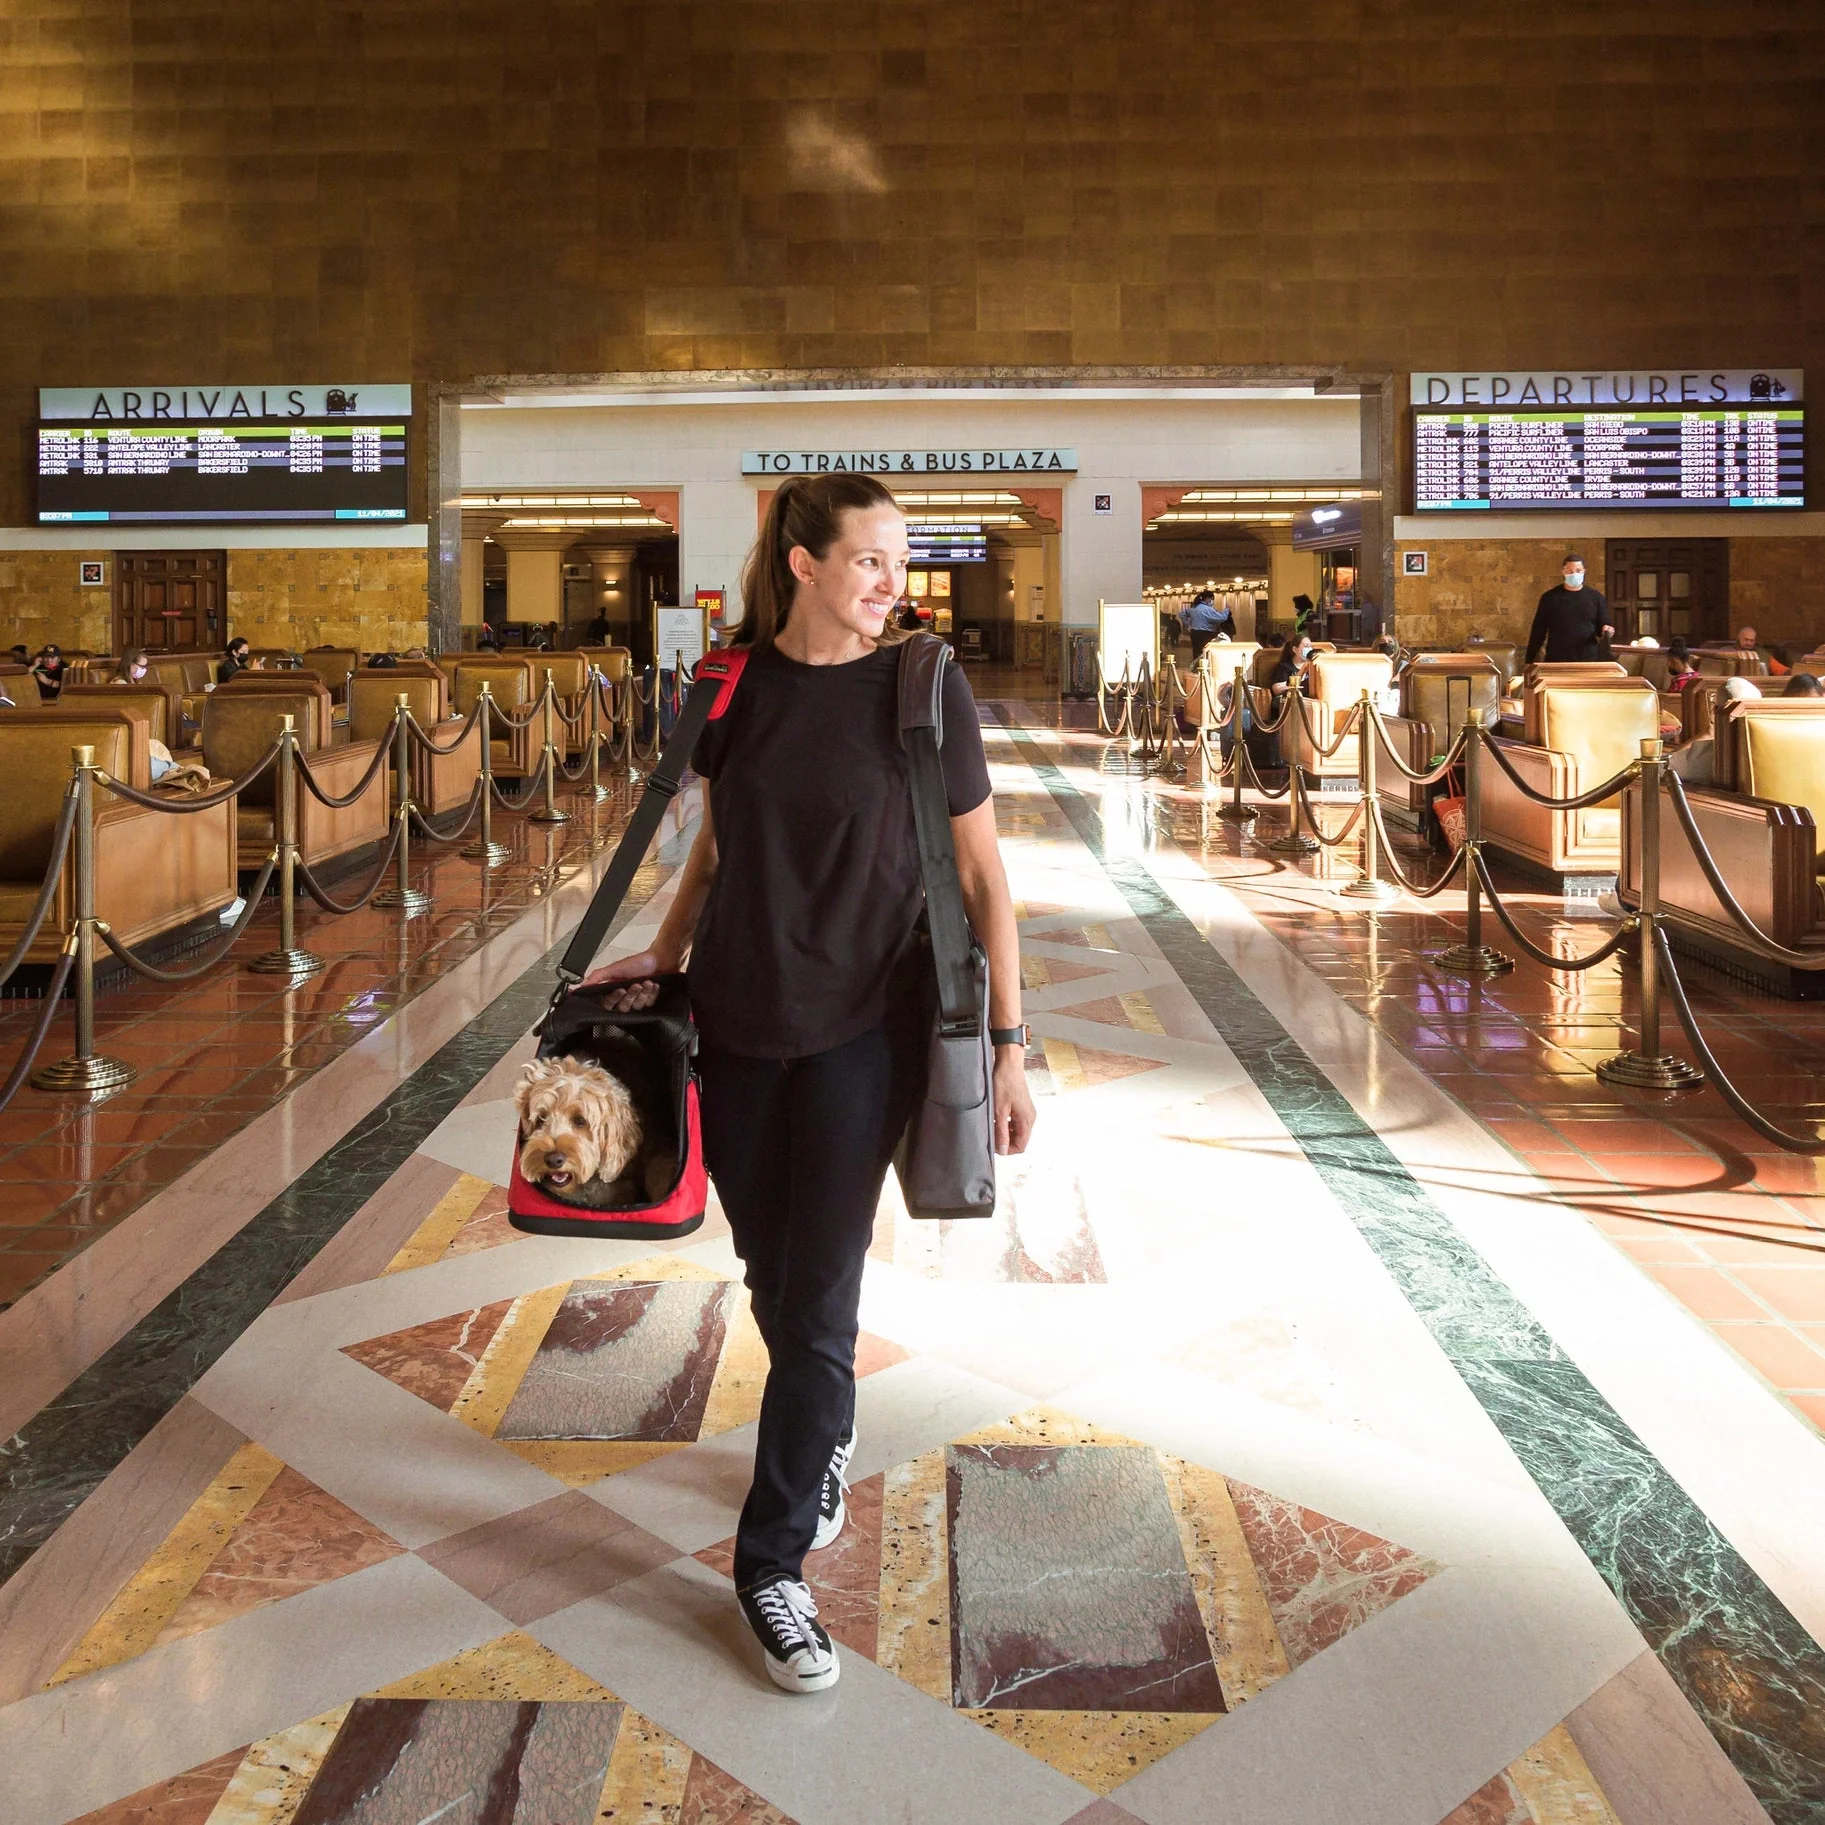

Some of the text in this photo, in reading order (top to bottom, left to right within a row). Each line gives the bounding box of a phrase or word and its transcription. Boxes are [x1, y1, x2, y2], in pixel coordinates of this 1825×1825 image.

[1428, 375, 1728, 404] DEPARTURES
[92, 390, 305, 418] ARRIVALS
[1463, 429, 1479, 437] 777
[40, 437, 80, 445] METROLINK
[108, 436, 140, 444] VENTURA
[198, 435, 236, 443] MOORPARK
[1417, 437, 1460, 445] METROLINK
[1519, 436, 1549, 444] COUNTY
[108, 444, 145, 452] ANTELOPE
[198, 443, 240, 451] LANCASTER
[1417, 445, 1460, 453] METROLINK
[1524, 444, 1554, 452] COUNTY
[40, 452, 80, 460] METROLINK
[123, 451, 168, 459] BERNARDINO
[1417, 453, 1460, 461] METROLINK
[1505, 452, 1552, 460] BERNARDINO
[108, 459, 136, 467] AMTRAK
[198, 458, 248, 466] BAKERSFIELD
[757, 451, 1063, 471] TO TRAINS & BUS PLAZA
[1417, 461, 1460, 469] METROLINK
[1489, 460, 1528, 468] ANTELOPE
[1584, 459, 1628, 467] LANCASTER
[1584, 467, 1612, 475] PERRIS
[1584, 475, 1611, 483] IRVINE
[1417, 492, 1460, 500] METROLINK
[1532, 491, 1562, 499] VALLEY
